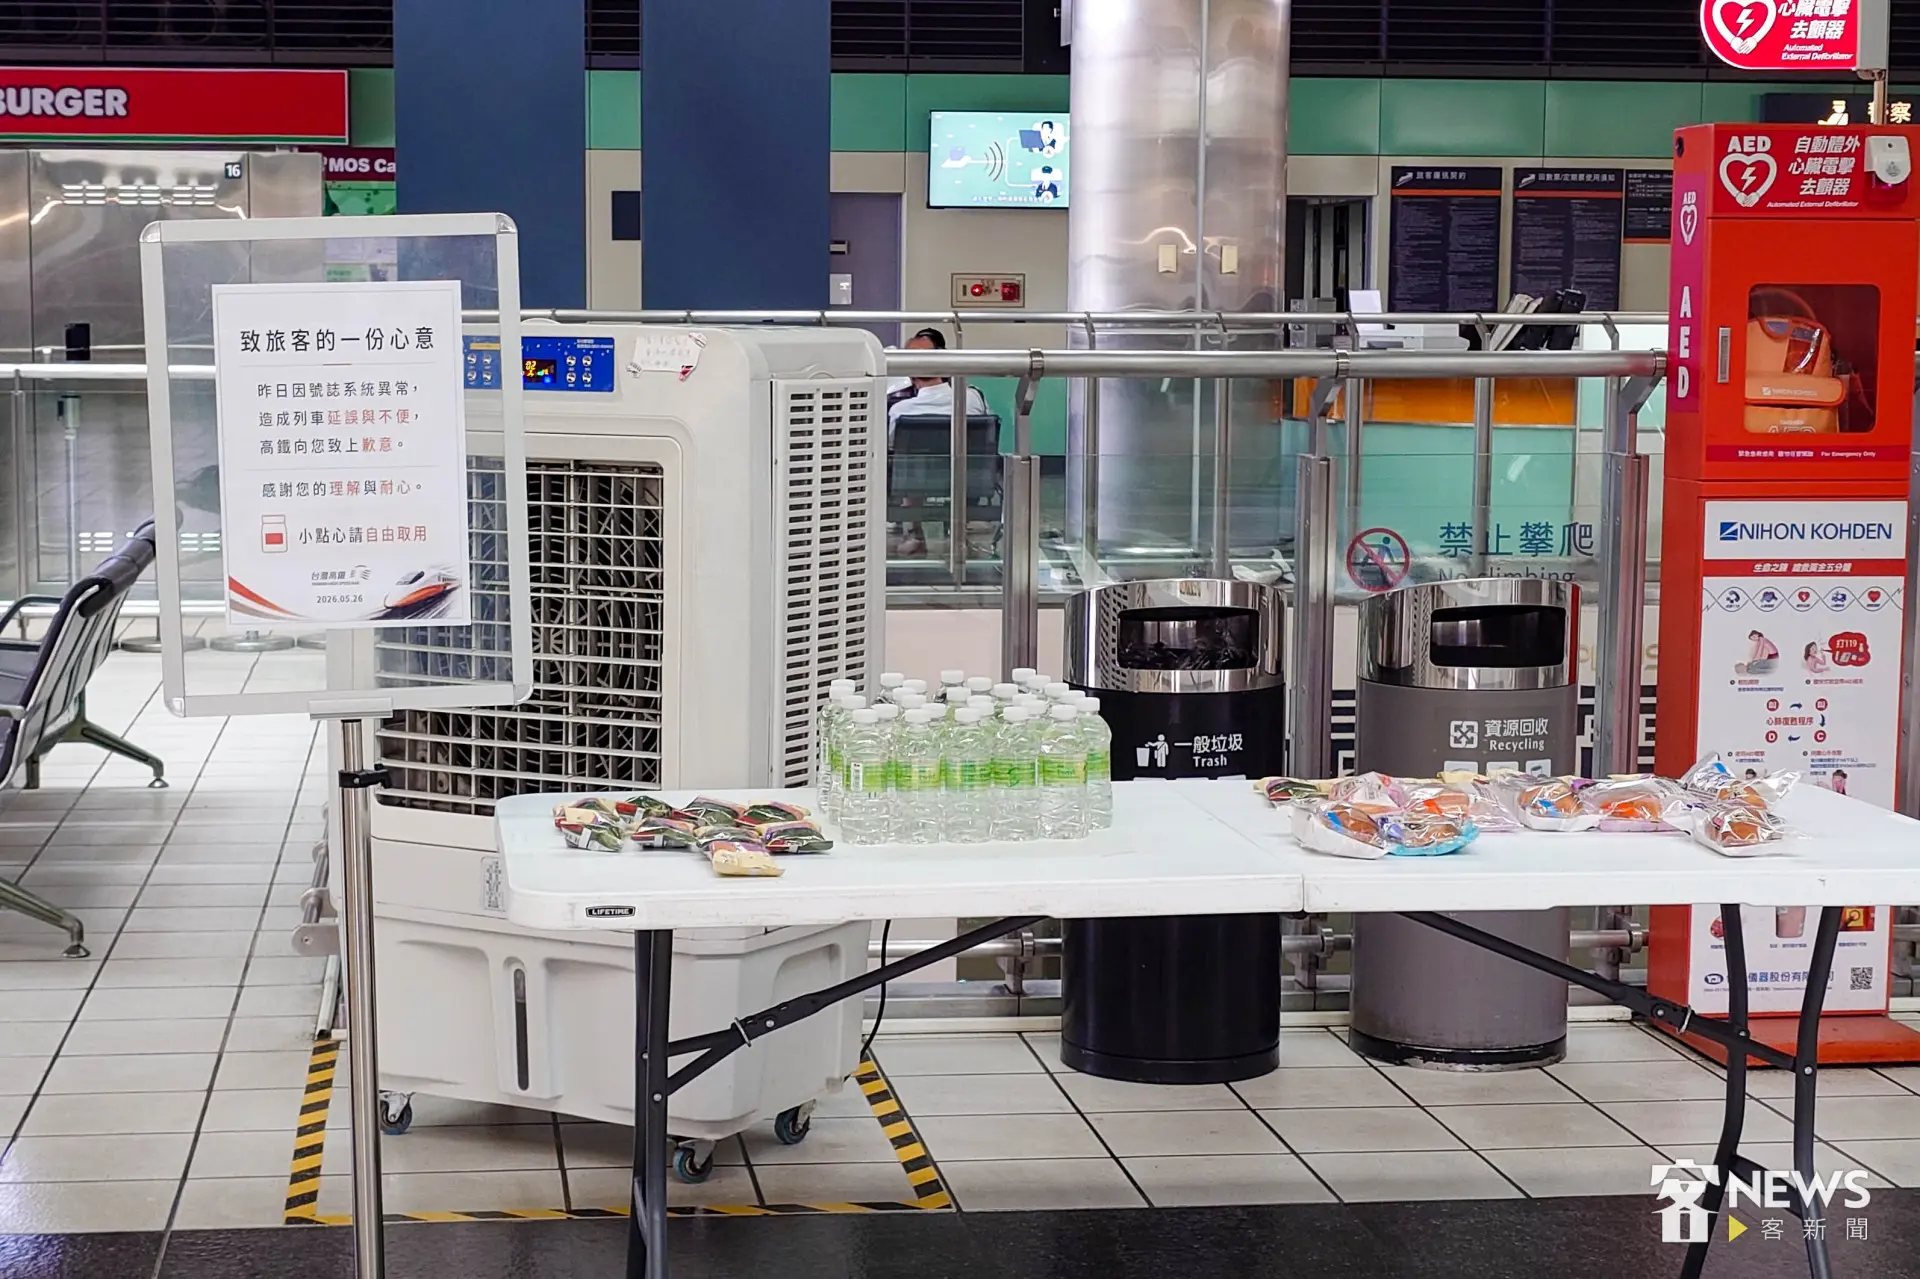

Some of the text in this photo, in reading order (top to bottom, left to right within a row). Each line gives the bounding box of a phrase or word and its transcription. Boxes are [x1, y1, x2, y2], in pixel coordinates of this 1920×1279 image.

[1790, 19, 1845, 39] 去顫器
[1783, 43, 1824, 51] Automated
[1781, 52, 1854, 61] External Defibrillator
[0, 87, 128, 117] URGER
[1727, 136, 1771, 153] AED
[1794, 136, 1860, 154] 自動體外
[226, 164, 241, 177] 16
[1788, 157, 1855, 176] 心臟電擊
[1800, 178, 1850, 196] 去顫器
[1683, 191, 1697, 205] AED
[240, 326, 435, 353] 致旅客的一份心意
[1677, 285, 1692, 398] AED
[260, 436, 404, 455] 高鐵向您致上歉意。
[1831, 451, 1862, 459] Emergency
[1863, 450, 1876, 458] Only
[262, 480, 423, 498] 感謝您的理解與耐心。
[299, 526, 427, 545] 小點心請自由取用
[1439, 521, 1594, 558] 禁止攀爬
[1739, 523, 1892, 540] NIHON KOHDEN
[316, 594, 363, 604] 2026.05.26
[1484, 717, 1549, 737] 資源回收
[1174, 733, 1243, 754] 一般垃圾
[1489, 738, 1545, 753] Recycling
[1193, 754, 1227, 768] Trash
[592, 907, 630, 916] LIFETIME
